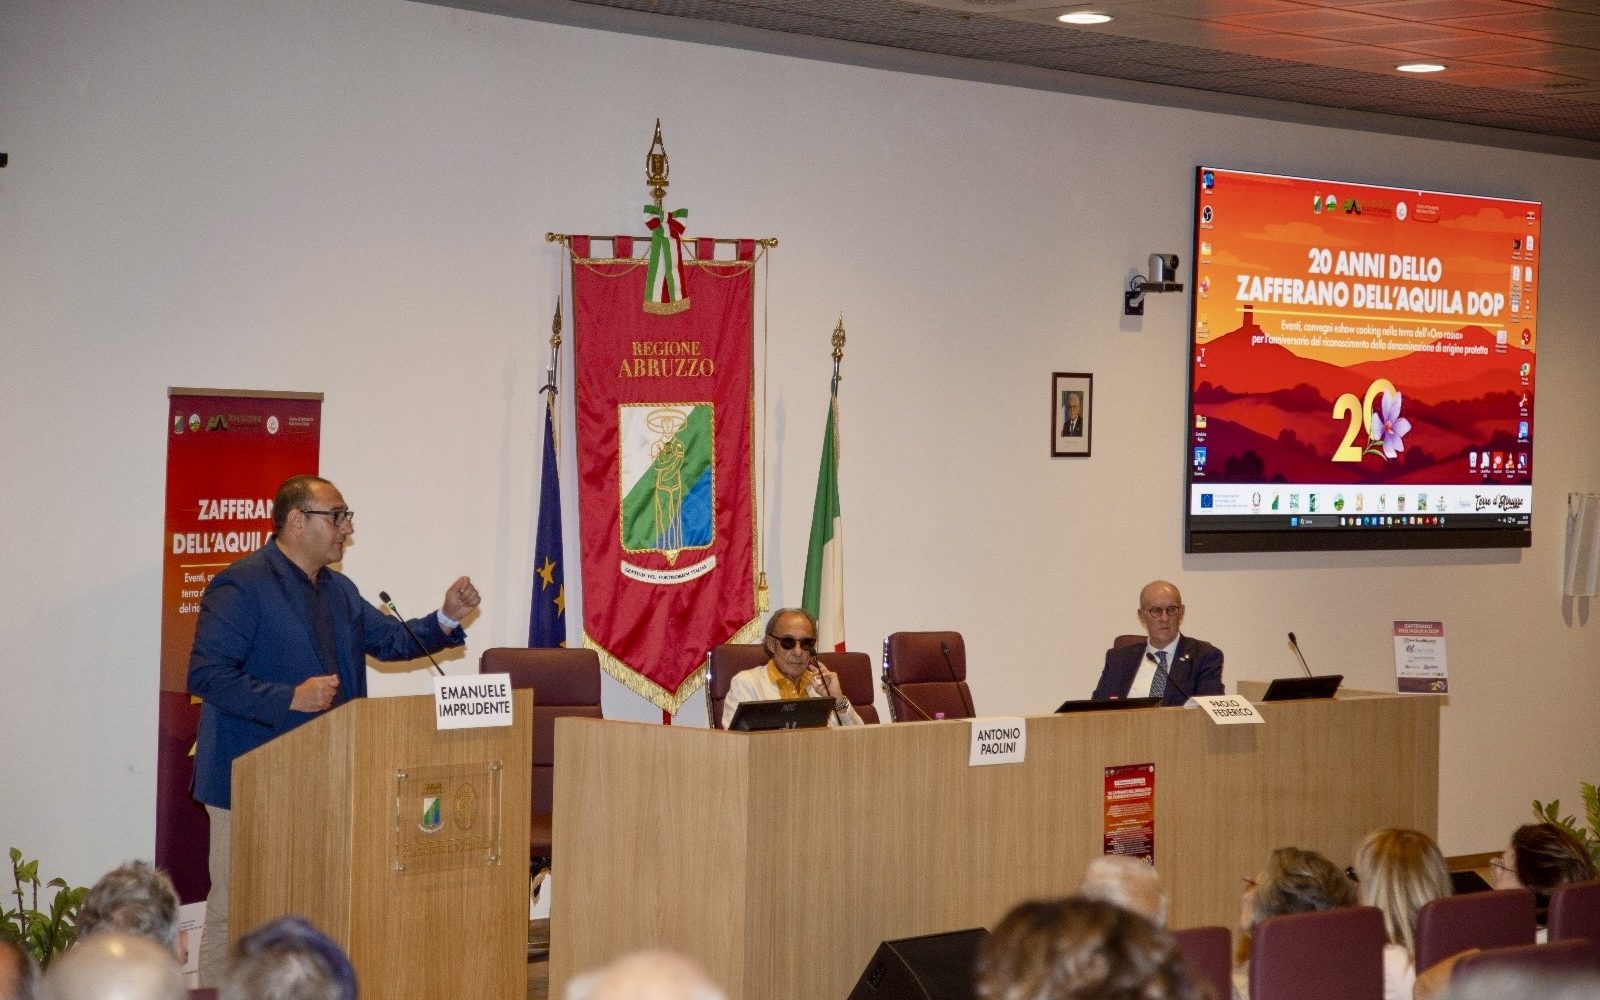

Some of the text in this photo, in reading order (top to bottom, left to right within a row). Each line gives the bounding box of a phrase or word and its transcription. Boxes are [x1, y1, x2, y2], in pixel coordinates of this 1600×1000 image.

[1308, 247, 1442, 283] 20 ANNI DELLO
[1235, 274, 1350, 308] ZAFFERANO
[1353, 283, 1464, 315] DELL'AQUILA
[1467, 291, 1505, 317] DOP
[1281, 319, 1302, 332] Eventi,
[1303, 322, 1333, 335] convegni
[1355, 323, 1381, 338] cooking
[1382, 325, 1398, 336] nella
[1398, 327, 1414, 337] terra
[632, 341, 701, 356] REGIONE
[1251, 335, 1265, 347] per
[1311, 335, 1321, 346] del
[1322, 337, 1369, 349] riconoscimento
[1370, 339, 1386, 350] della
[1387, 340, 1435, 352] denominazione
[1435, 341, 1442, 352] di
[1442, 343, 1464, 356] origine
[1464, 344, 1489, 356] protetta
[619, 358, 715, 378] ABRUZZO
[1331, 378, 1398, 462] 20
[179, 602, 191, 613] del
[441, 684, 507, 700] EMANUELE
[439, 700, 510, 717] IMPRUDENTE
[1209, 700, 1240, 708] PAOLO
[1212, 707, 1253, 718] FEDERICO
[977, 727, 1021, 741] ANTONIO
[980, 742, 1016, 755] PAOLINI
